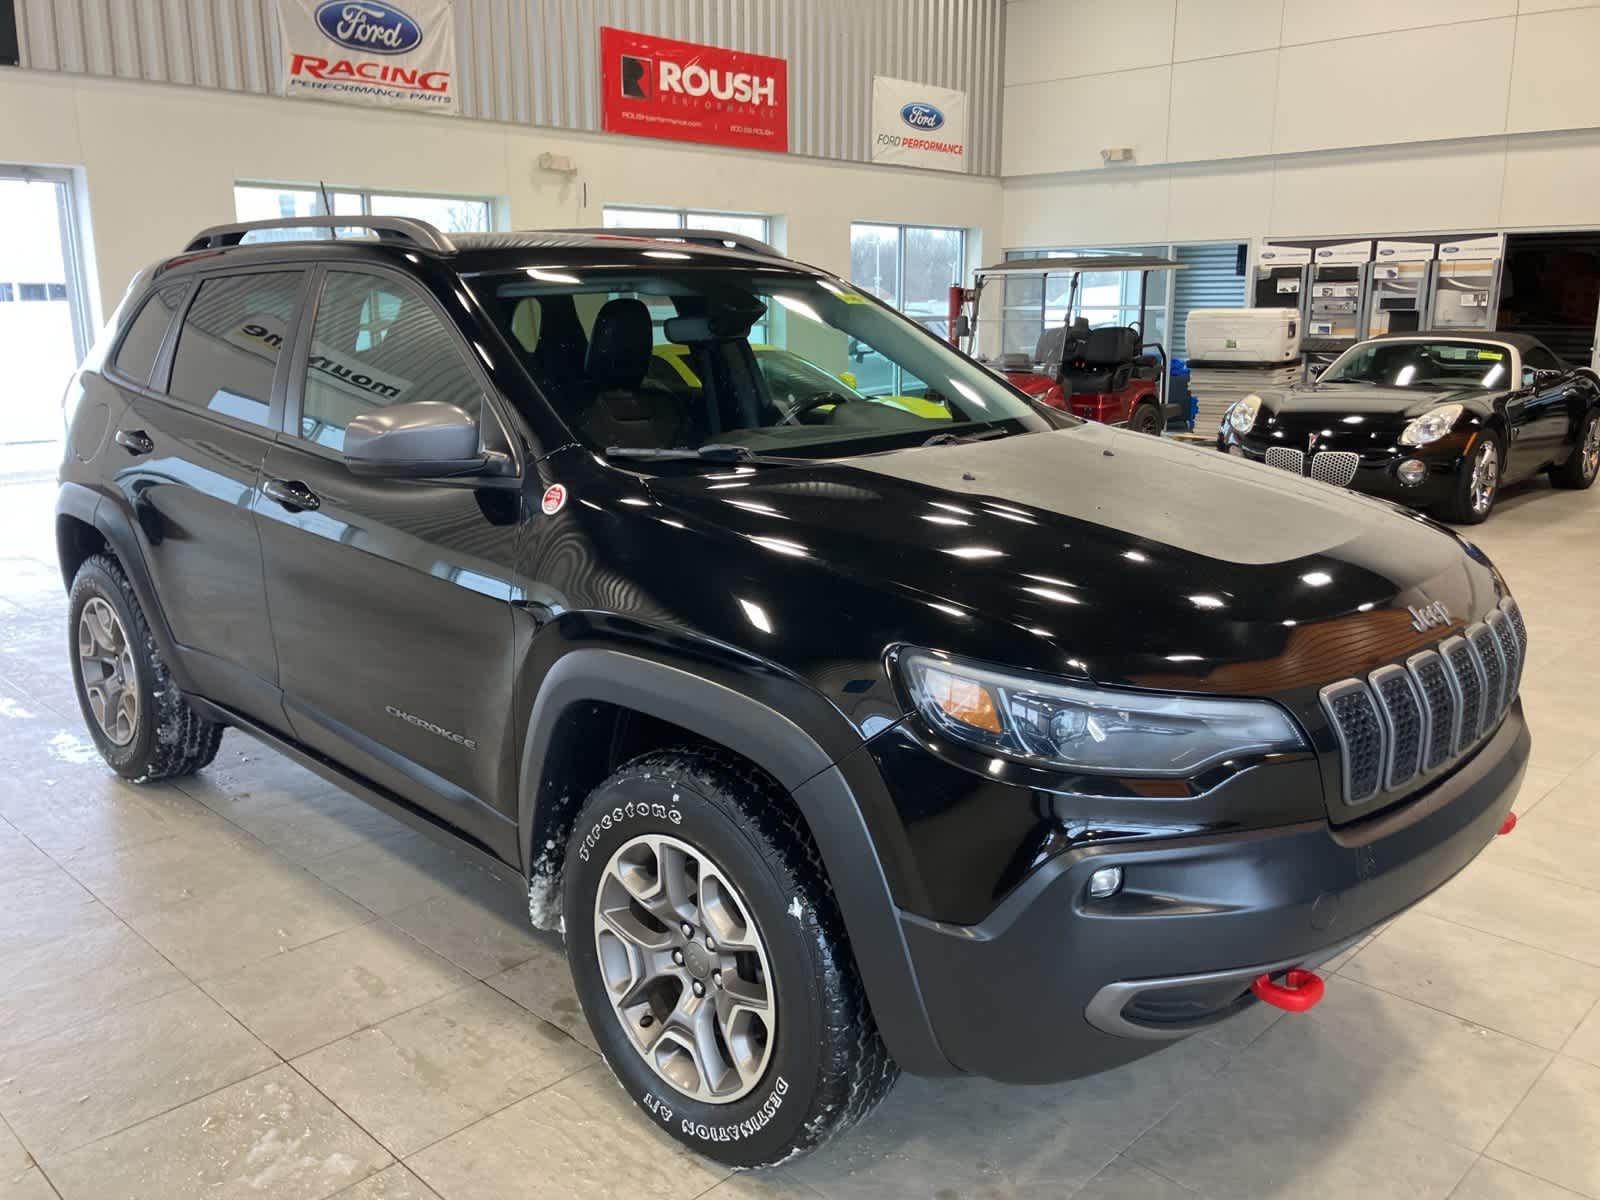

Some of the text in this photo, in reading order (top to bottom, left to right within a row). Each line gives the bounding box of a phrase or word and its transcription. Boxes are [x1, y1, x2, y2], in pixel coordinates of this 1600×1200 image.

[336, 4, 402, 47] Ford
[290, 54, 450, 92] RACING
[290, 79, 452, 103] PERFORMANCE PARTS
[659, 61, 775, 106] ROUSH
[909, 106, 937, 126] Ford
[877, 134, 964, 155] FORD PERFORMANCE
[1407, 600, 1451, 633] Jeep
[384, 705, 476, 751] CHEROKEE
[579, 801, 682, 862] Firestone
[682, 1076, 789, 1141] DESTINATION
